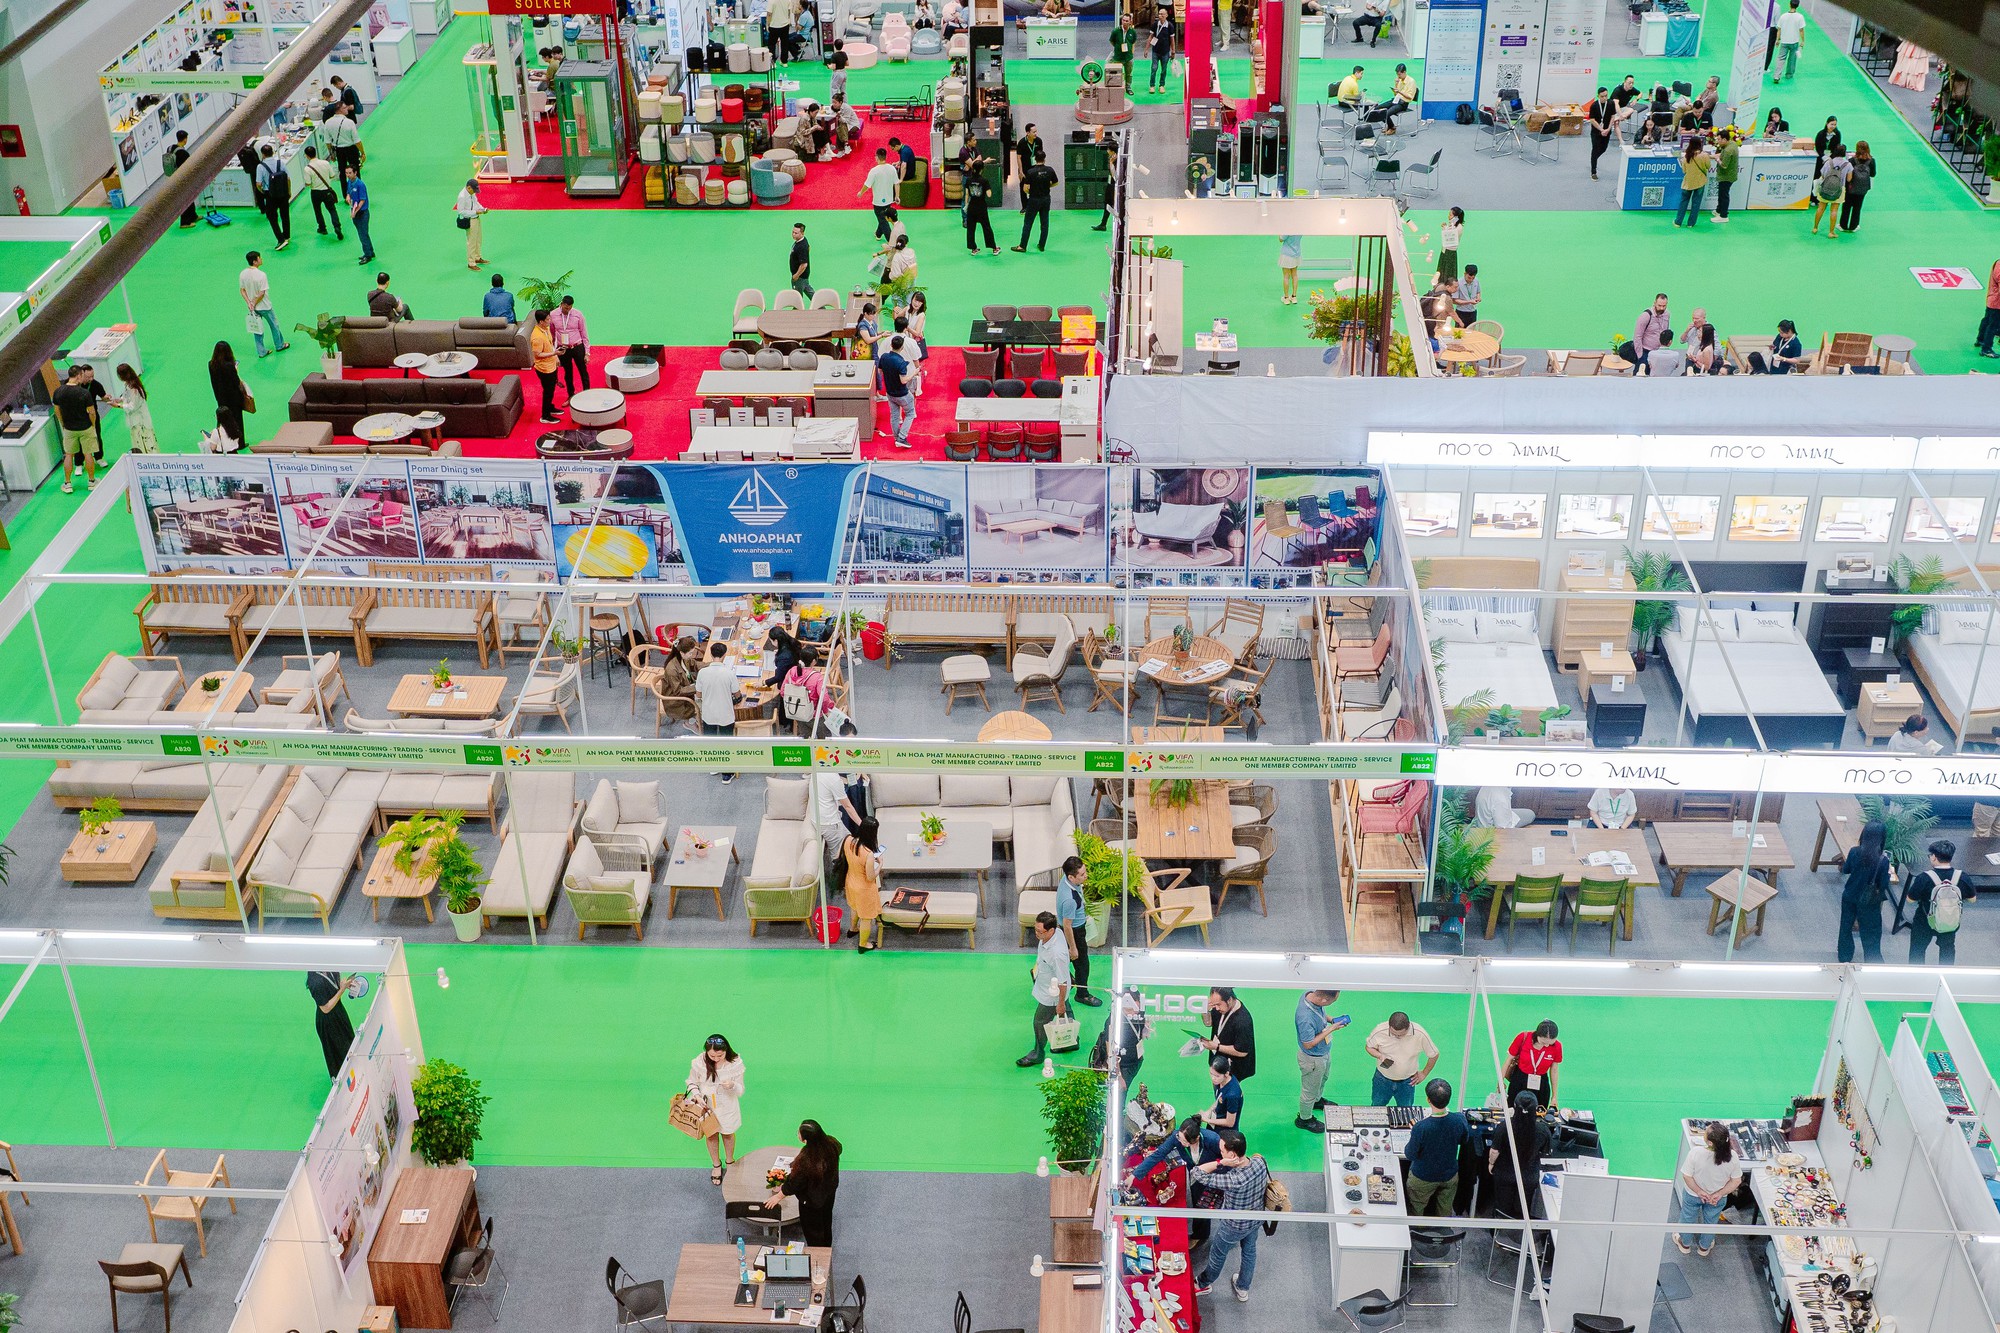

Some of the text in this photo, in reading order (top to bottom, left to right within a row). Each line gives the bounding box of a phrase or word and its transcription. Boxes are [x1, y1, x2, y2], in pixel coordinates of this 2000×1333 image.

[515, 0, 572, 9] SOLKER
[1638, 162, 1676, 173] pingpong
[1508, 442, 1571, 462] MMML
[1781, 444, 1844, 464] MMML
[162, 462, 189, 471] Dining
[276, 463, 308, 473] Triangle
[310, 464, 338, 473] Dining
[441, 465, 468, 475] Dining
[718, 533, 802, 544] ANHOAPHAT
[329, 744, 388, 753] MANUFACTURING
[362, 750, 396, 758] COMPANY
[1602, 762, 1680, 786] MMML
[1931, 768, 2000, 790] MMML
